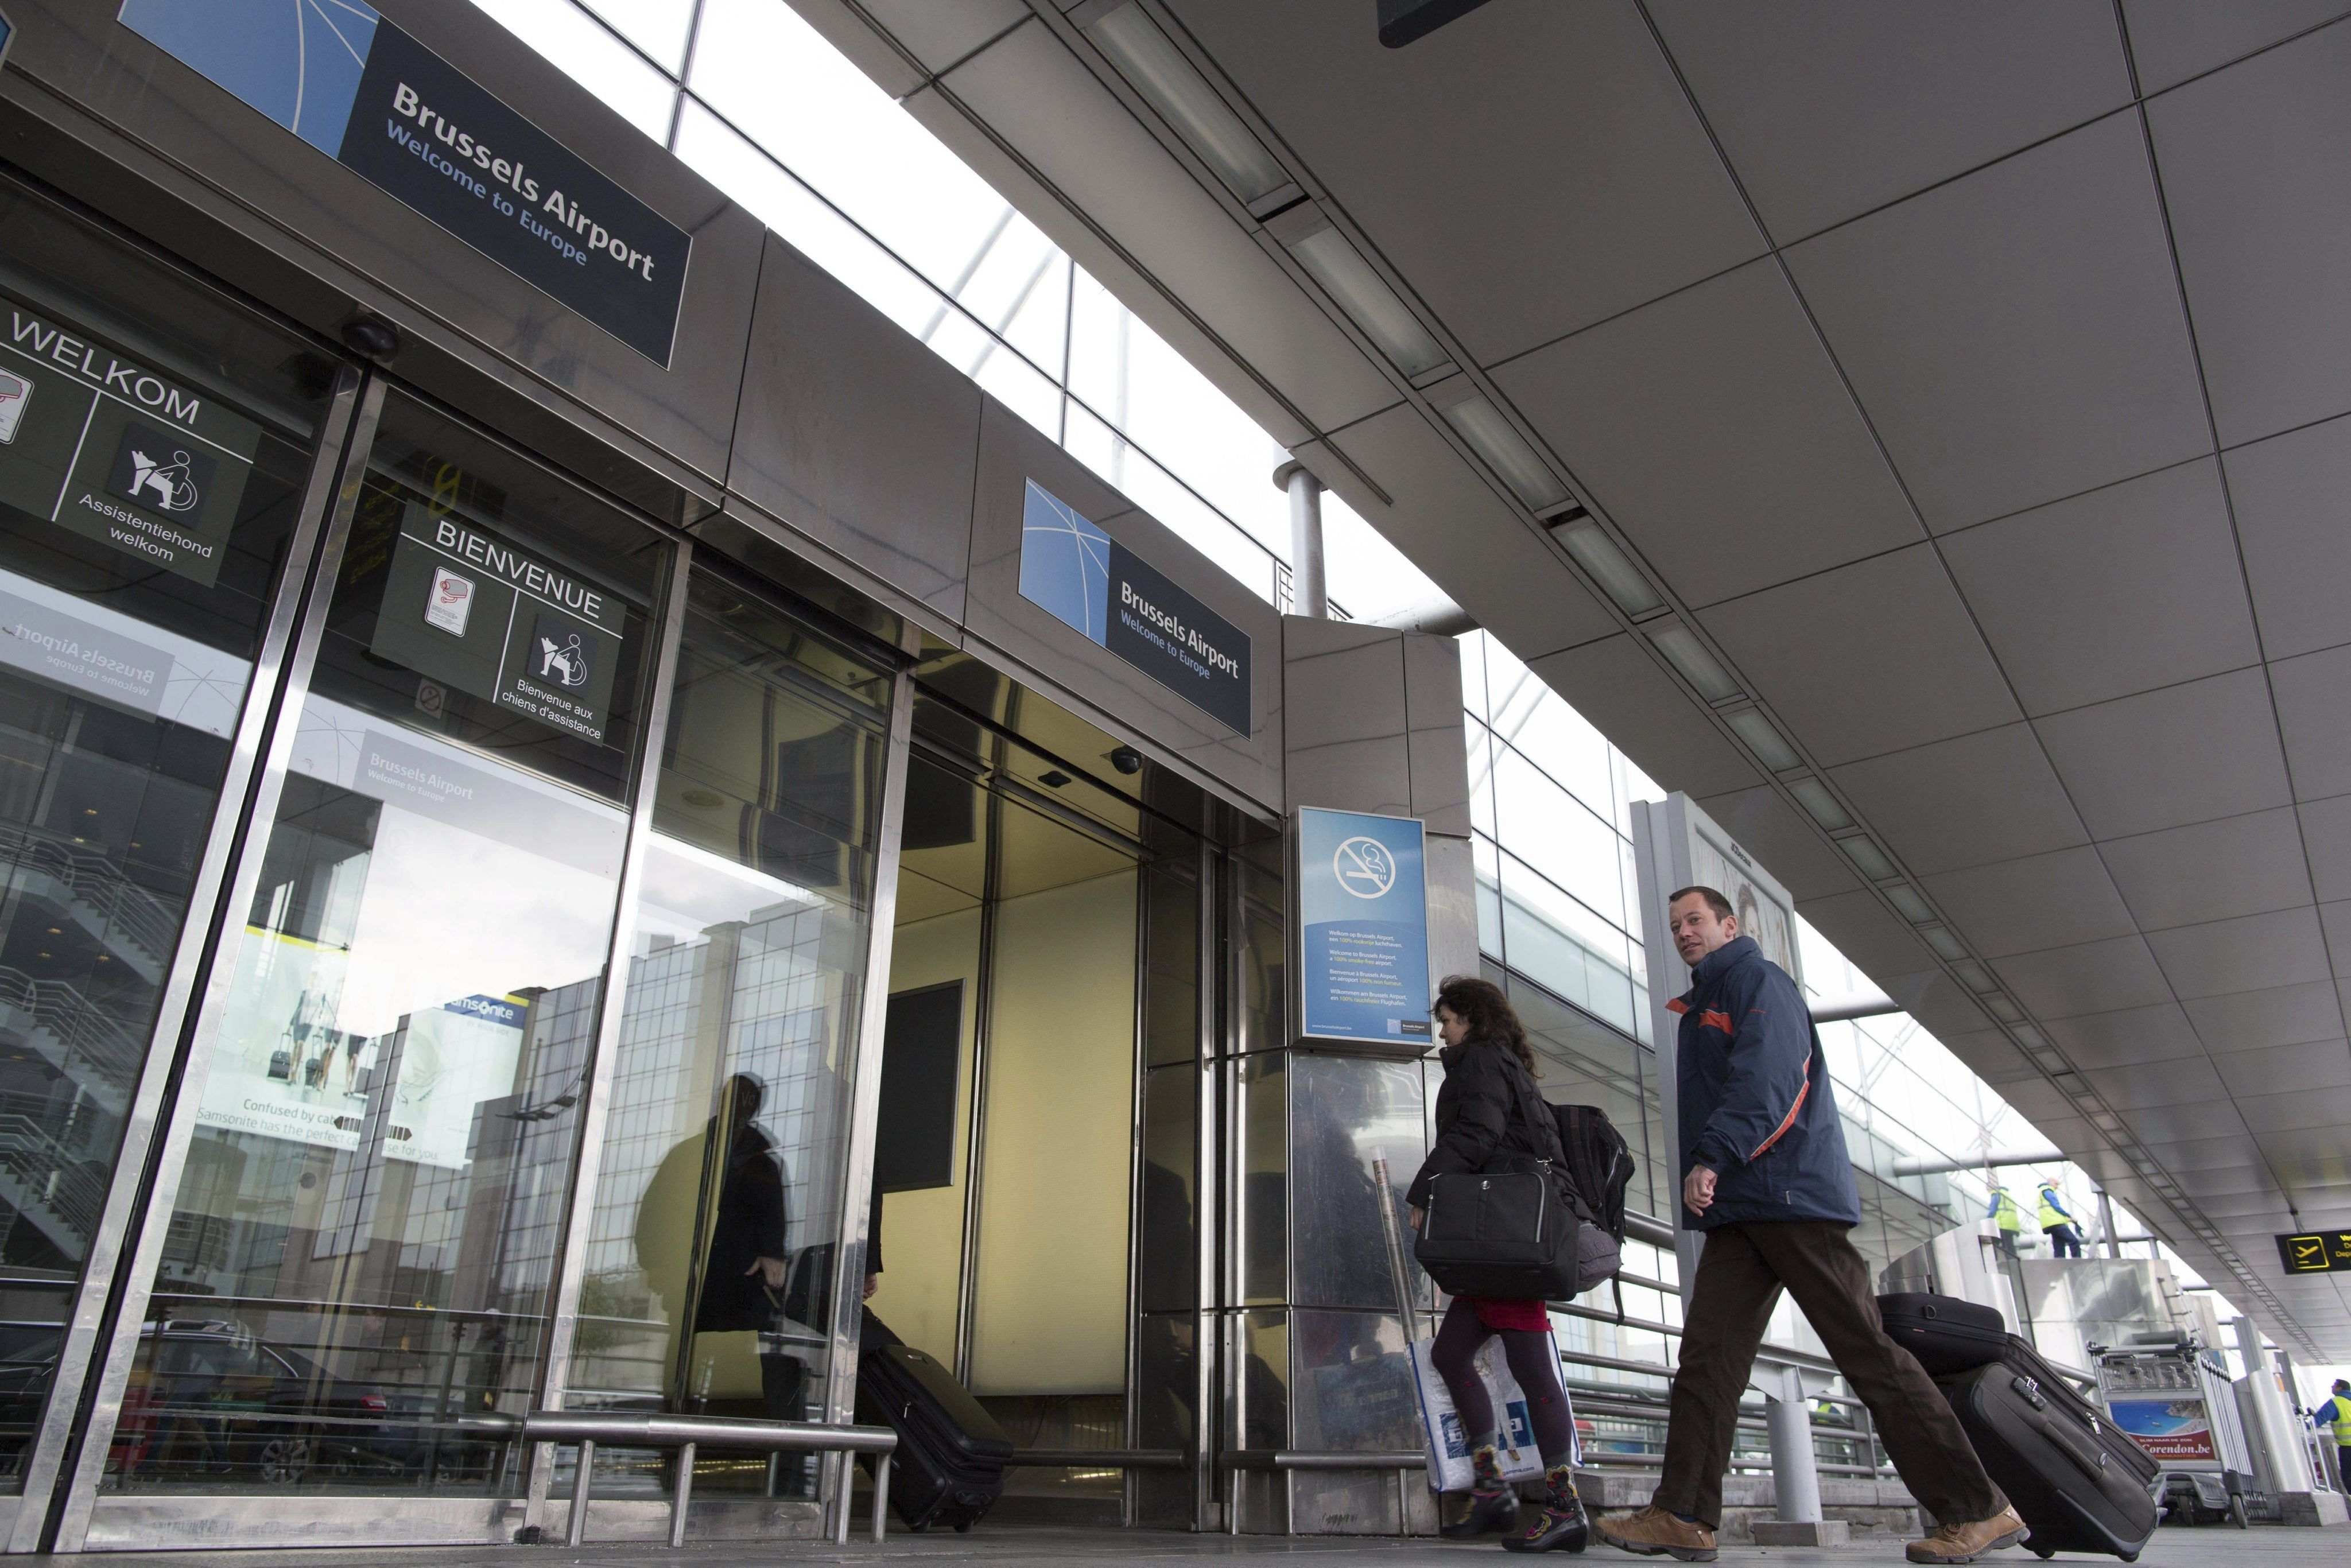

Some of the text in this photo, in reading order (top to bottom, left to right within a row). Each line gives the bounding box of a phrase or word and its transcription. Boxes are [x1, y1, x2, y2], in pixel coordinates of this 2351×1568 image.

[388, 118, 587, 266] Welcome to Europe
[393, 82, 654, 281] Brussels Airport
[13, 312, 200, 425] WELKOM
[79, 494, 212, 558] Assistentiehond
[110, 527, 173, 561] welkom
[436, 520, 602, 619] BIENVENUE
[1120, 609, 1210, 680] Welcome to Europe
[1121, 581, 1239, 679] Brussels Airport
[502, 692, 601, 740] chiens d'assistance
[518, 680, 593, 720] Bienvenue aux
[368, 769, 445, 802] Welcome to Europe
[370, 753, 474, 799] Brussels Airport
[197, 1108, 257, 1128] Samsonite
[261, 1119, 280, 1132] has
[284, 1124, 303, 1136] the
[306, 1128, 344, 1142] perfect
[243, 1099, 298, 1118] Confused
[301, 1110, 314, 1123] by
